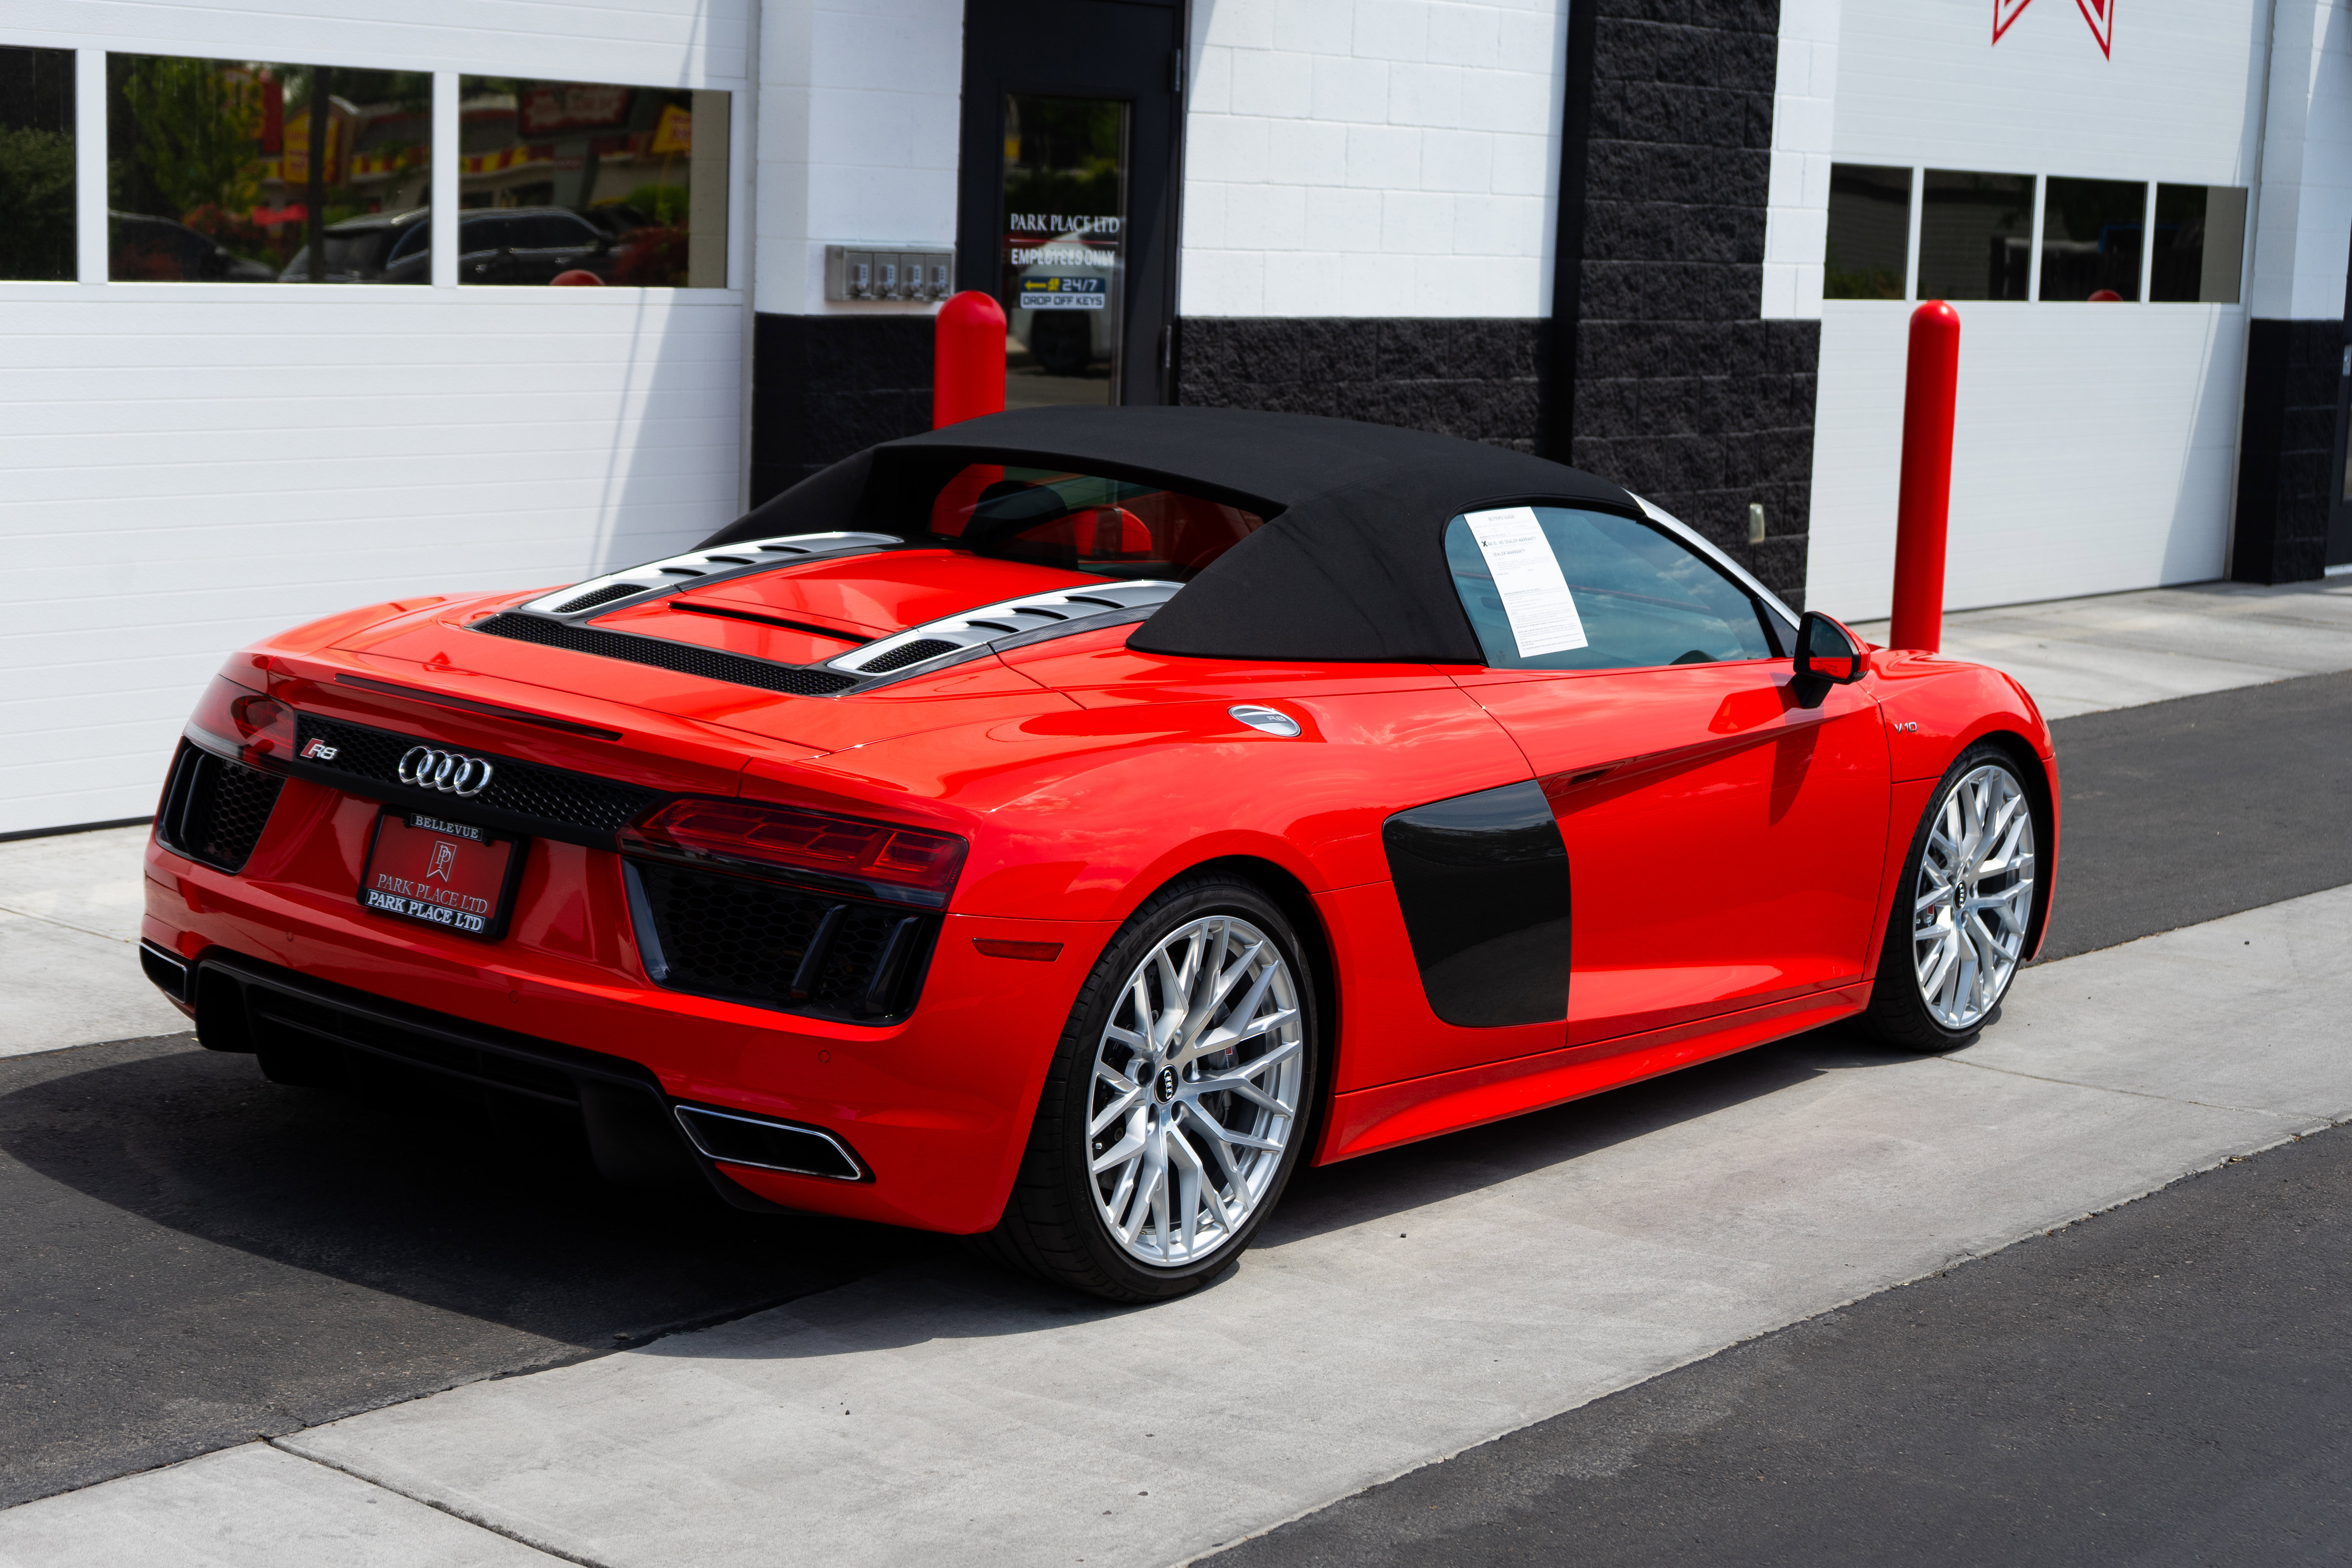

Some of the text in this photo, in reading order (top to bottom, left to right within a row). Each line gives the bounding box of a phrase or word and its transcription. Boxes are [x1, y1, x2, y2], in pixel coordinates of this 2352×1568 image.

[1010, 213, 1119, 233] PARK PLACE LTD
[1011, 248, 1115, 266] EMPLOYEES ONLY
[1062, 278, 1098, 292] 24/7
[1023, 296, 1102, 306] DROP OFF KEYS
[1894, 722, 1917, 734] V10
[308, 744, 337, 760] R8
[415, 815, 478, 839] BELLEVUE
[376, 873, 488, 914] PARK PLACE LTD
[368, 891, 483, 931] PARK PLACE LTD
